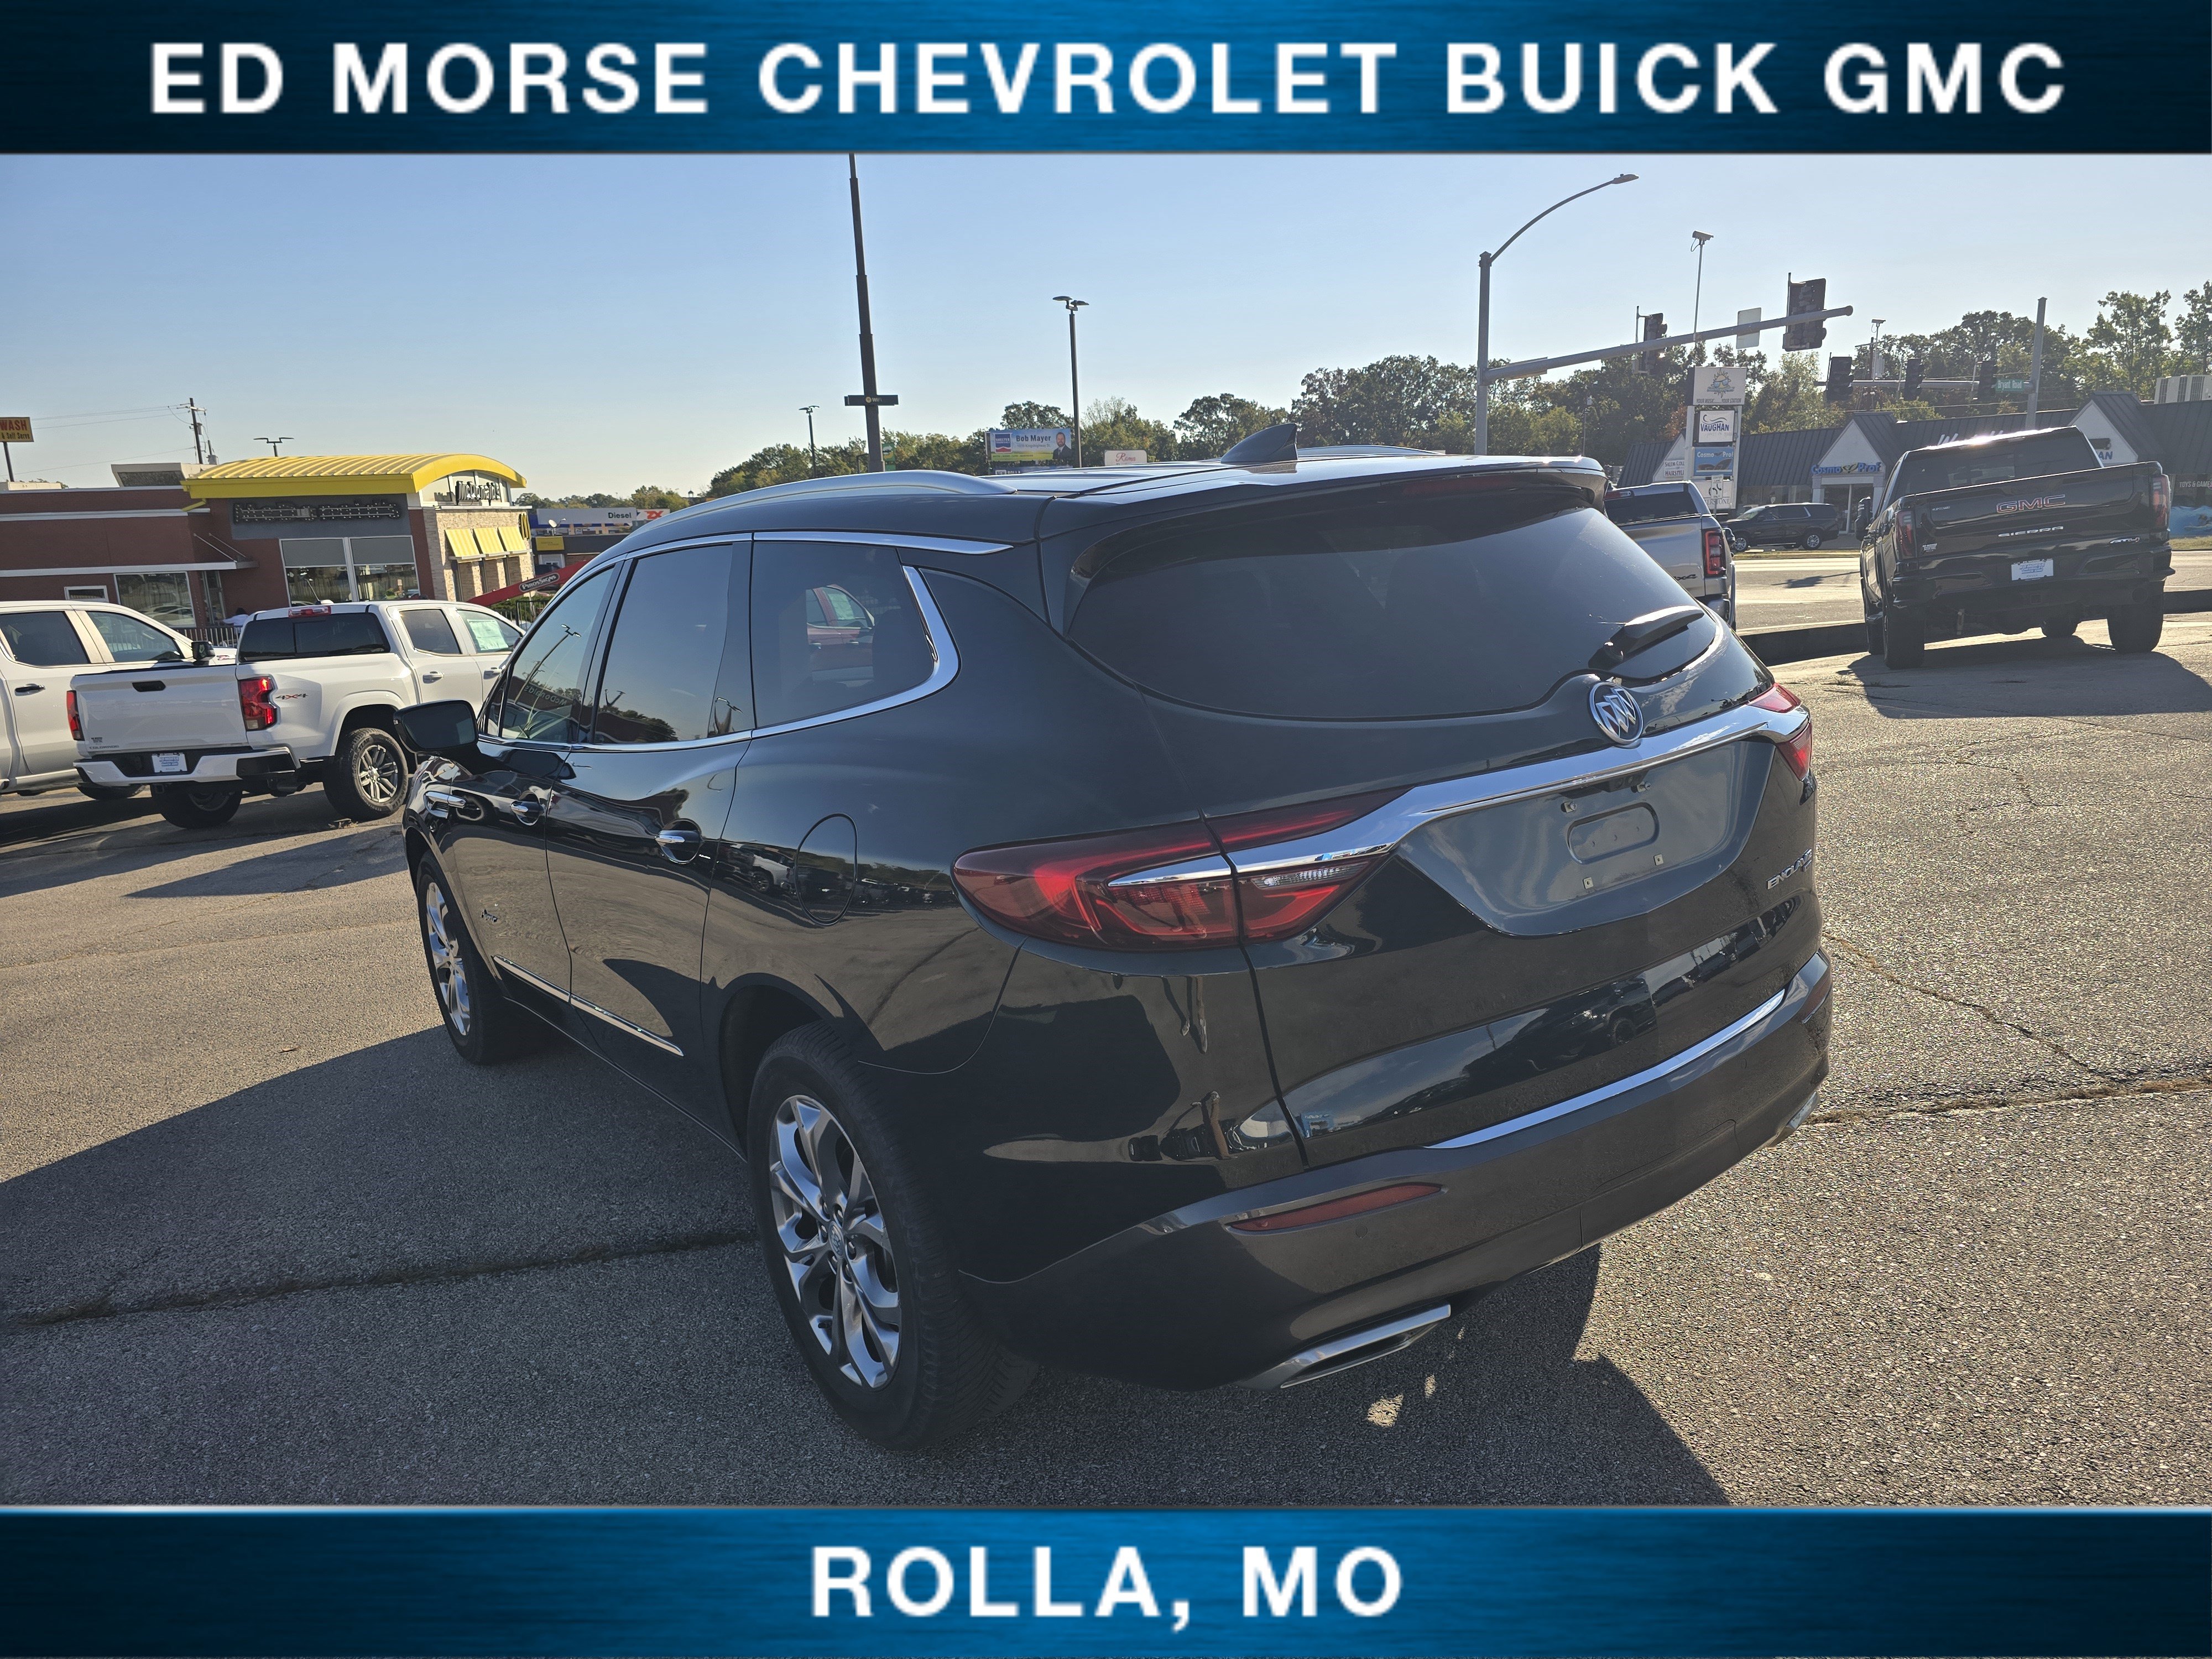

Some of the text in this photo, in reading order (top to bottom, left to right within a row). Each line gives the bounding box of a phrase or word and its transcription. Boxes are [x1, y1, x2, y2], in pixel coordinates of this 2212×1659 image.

[1998, 380, 2022, 390] Bryant Road
[1700, 423, 1729, 432] VAUGHAN
[1030, 435, 1051, 443] Mayer
[1116, 452, 1136, 462] Roma
[1811, 462, 1881, 474] Cosmo Prof
[1996, 494, 2065, 513] GMC
[233, 499, 400, 524] McDonald's
[1998, 526, 2064, 537] SIERRA
